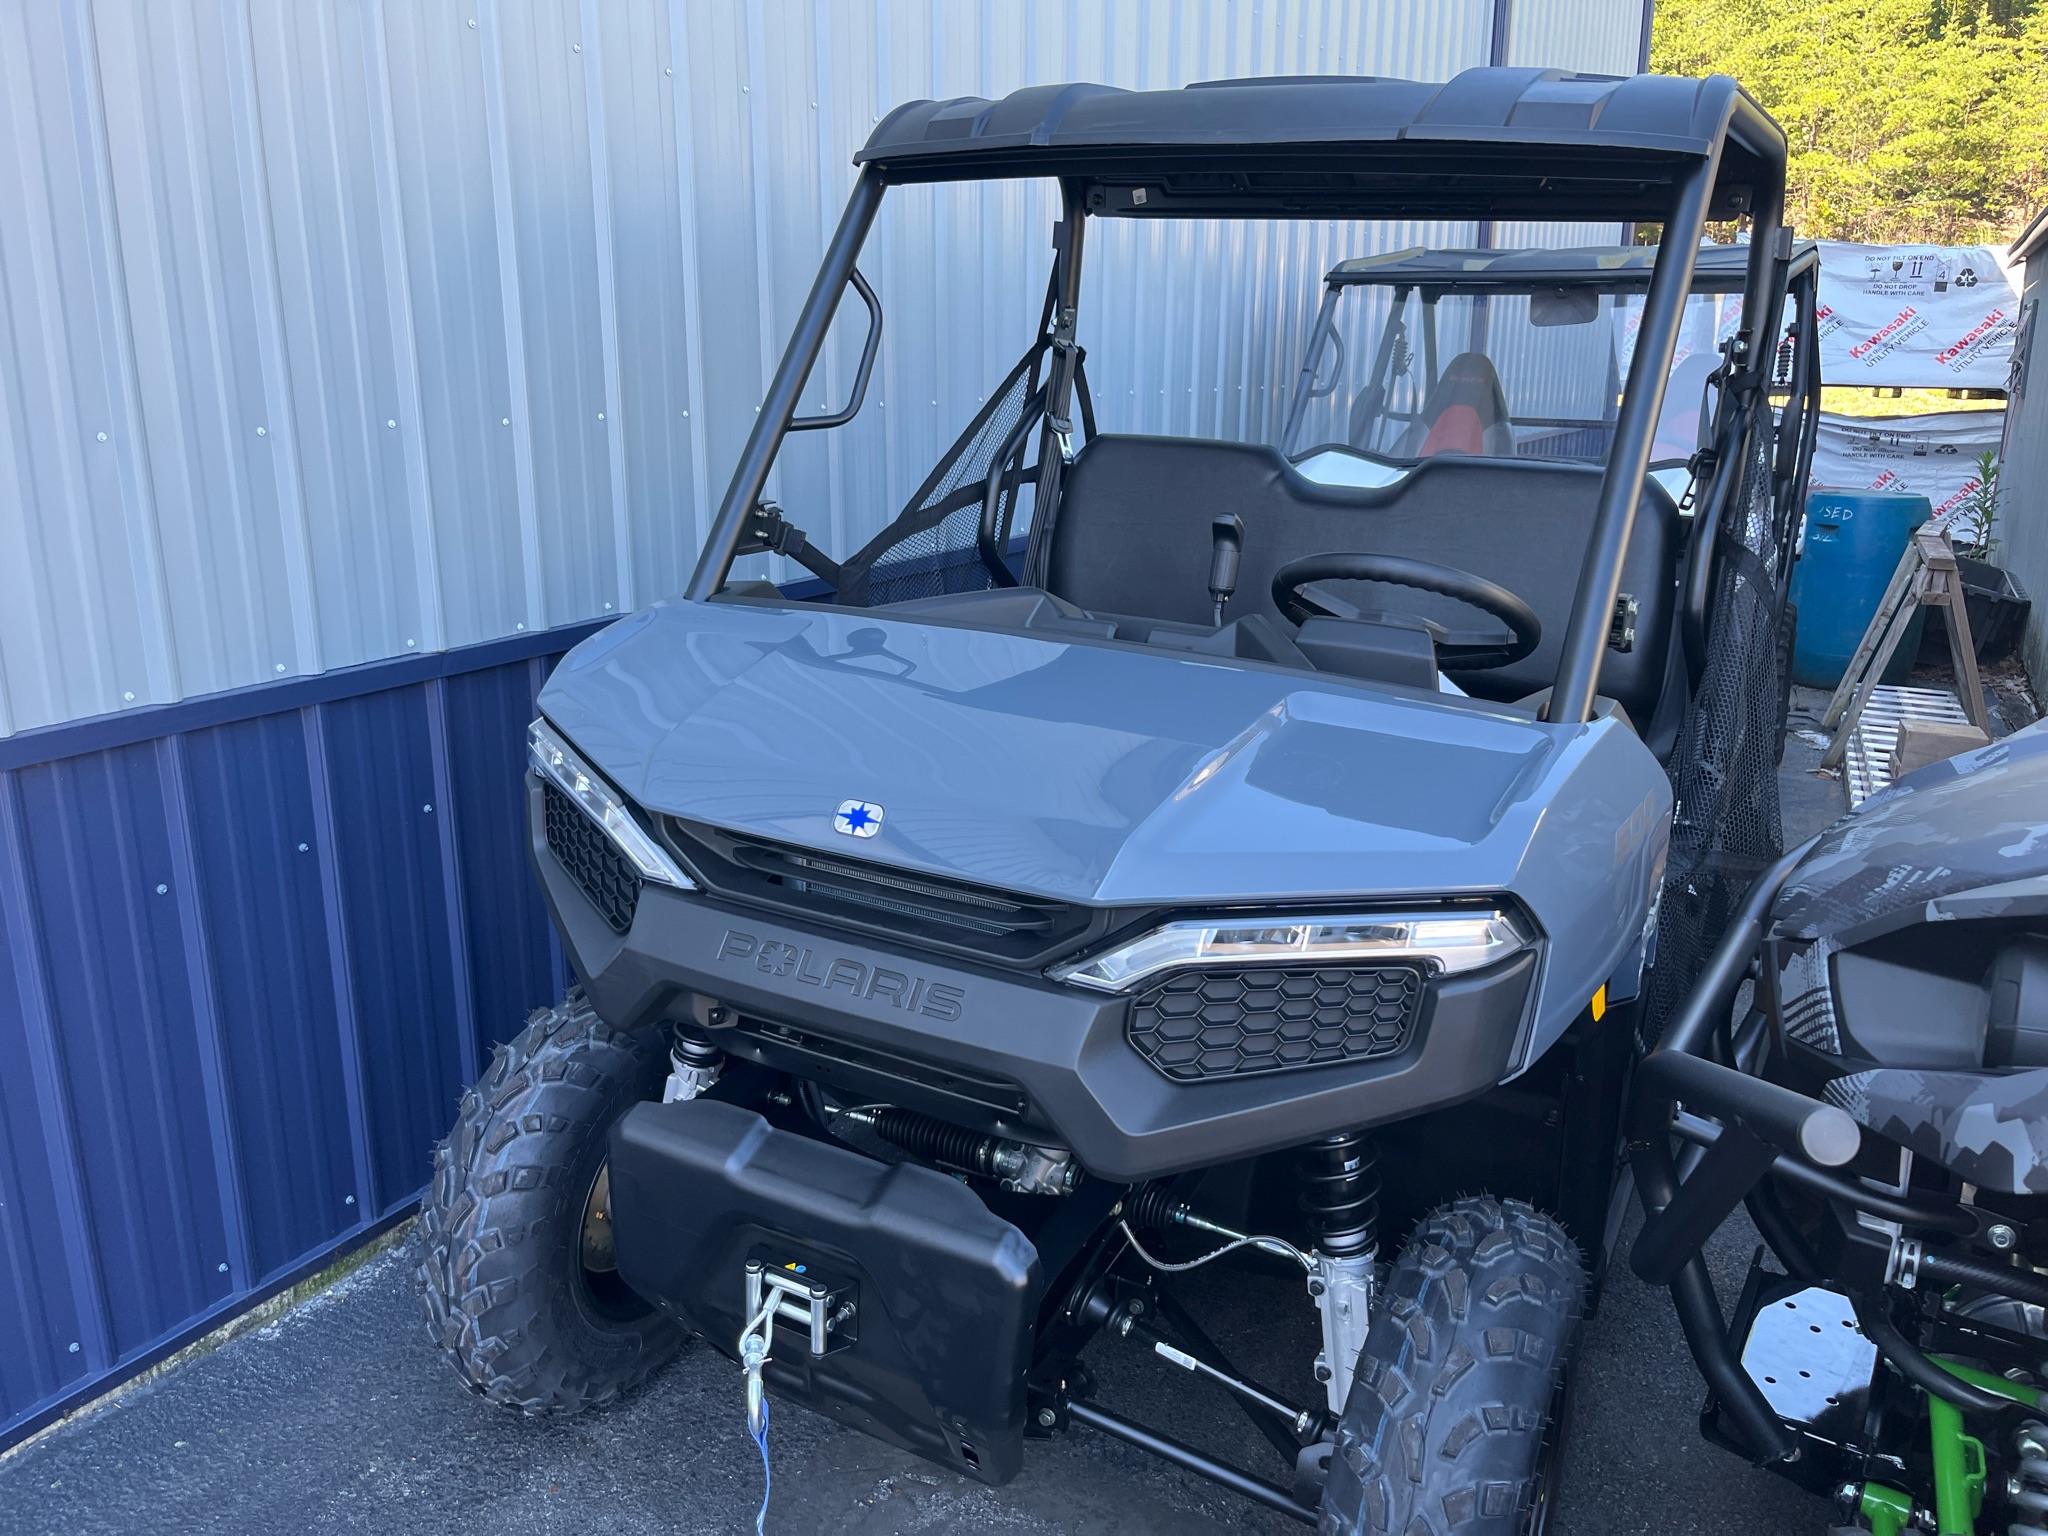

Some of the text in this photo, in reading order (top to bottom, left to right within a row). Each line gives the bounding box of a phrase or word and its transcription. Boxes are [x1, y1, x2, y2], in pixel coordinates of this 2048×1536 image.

[1938, 270, 1946, 280] 4
[1848, 306, 1917, 359] Kawasaki
[1866, 319, 1930, 368] UTILITY VEHICLE
[1935, 308, 2005, 365] Kawasaki
[1952, 321, 2018, 373] UTILITY VEHICLE
[716, 929, 966, 1022] POLARIS
